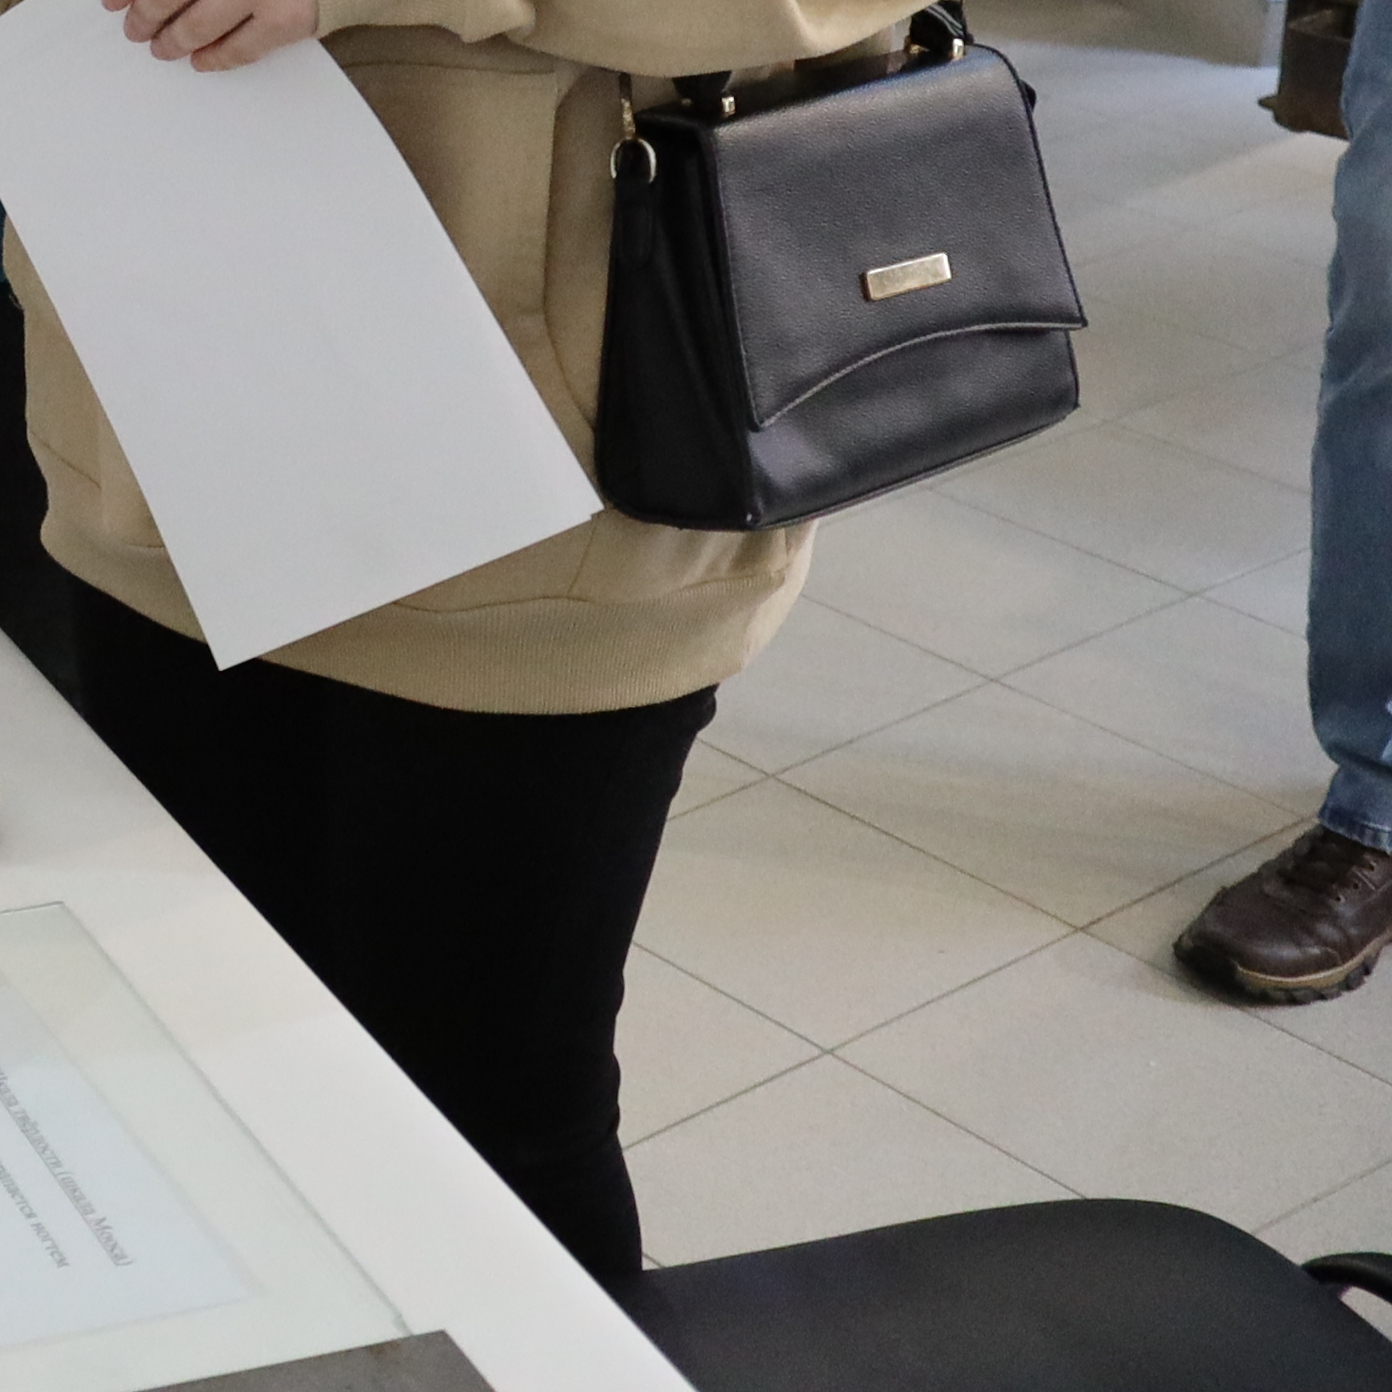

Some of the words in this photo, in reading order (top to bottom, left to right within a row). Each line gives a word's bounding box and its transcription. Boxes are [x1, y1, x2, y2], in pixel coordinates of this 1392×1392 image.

[9, 1109, 68, 1169] твёрдости
[51, 1170, 101, 1216] (шкала
[85, 1217, 137, 1267] Мооса)
[30, 1221, 73, 1267] ногтем
